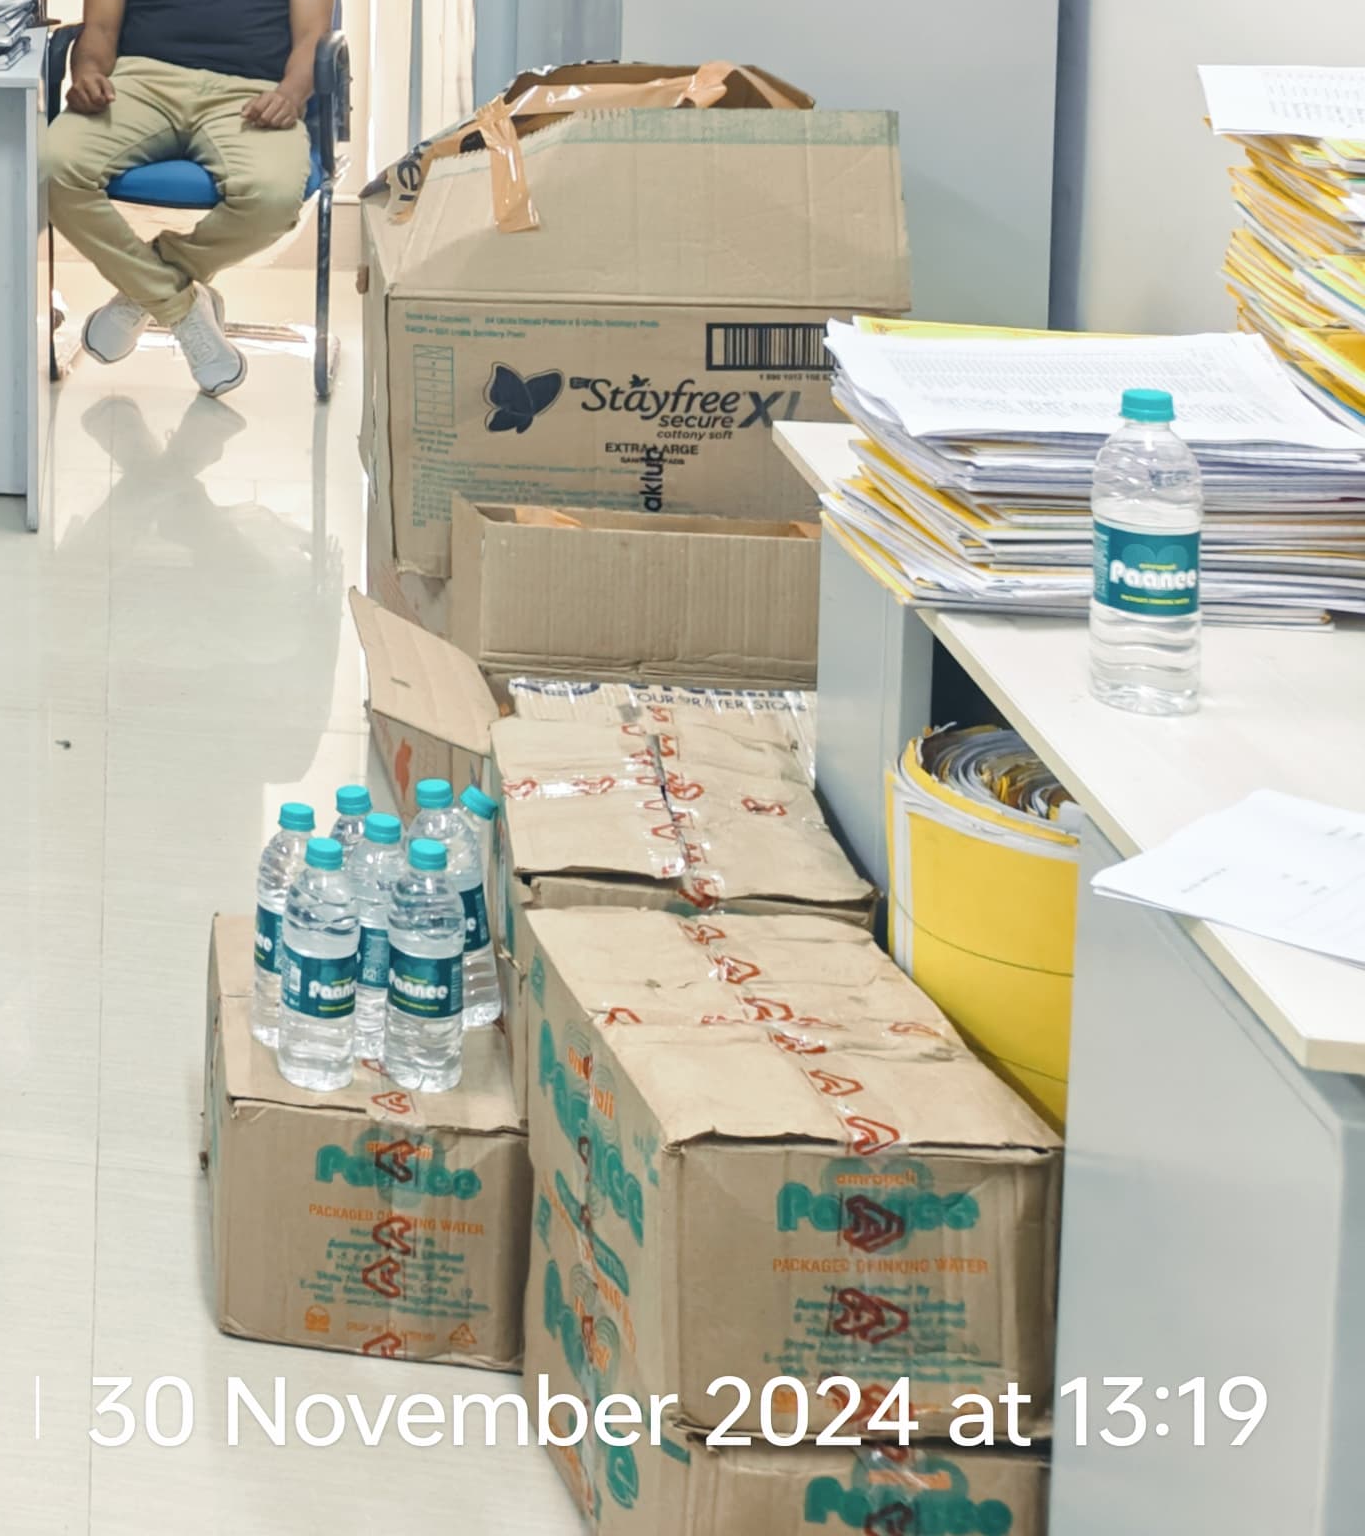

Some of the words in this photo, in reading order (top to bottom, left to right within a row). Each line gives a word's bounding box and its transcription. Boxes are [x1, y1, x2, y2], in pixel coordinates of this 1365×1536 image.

[581, 378, 741, 421] Stayfree
[658, 412, 735, 430] secure
[708, 429, 734, 441] soft
[605, 442, 649, 453] EXTRA
[1110, 559, 1197, 591] Paanee
[308, 1203, 374, 1223] PACKAGED
[440, 1216, 485, 1237] WATER
[934, 1257, 990, 1275] WATER
